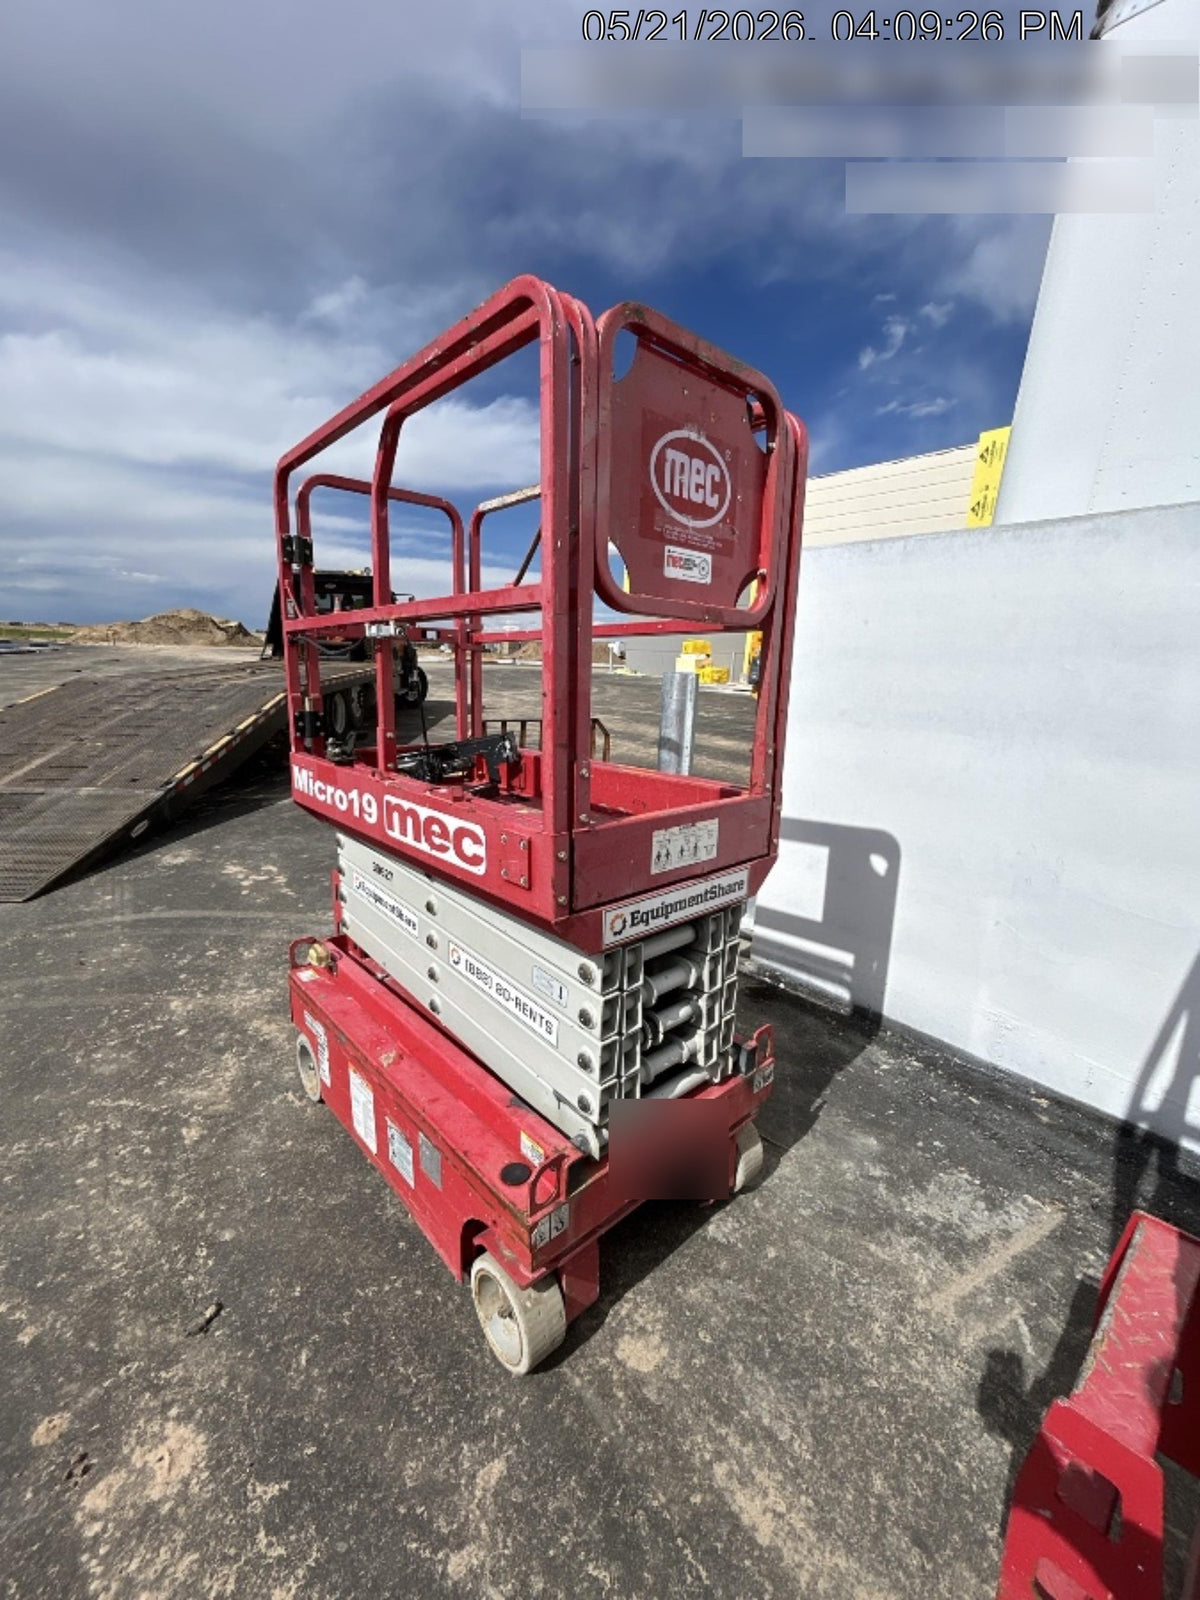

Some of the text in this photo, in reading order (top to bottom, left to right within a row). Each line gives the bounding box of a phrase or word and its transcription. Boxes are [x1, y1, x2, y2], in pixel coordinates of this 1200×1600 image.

[293, 764, 485, 869] Micro19 mec
[629, 878, 745, 928] EquipmentShare
